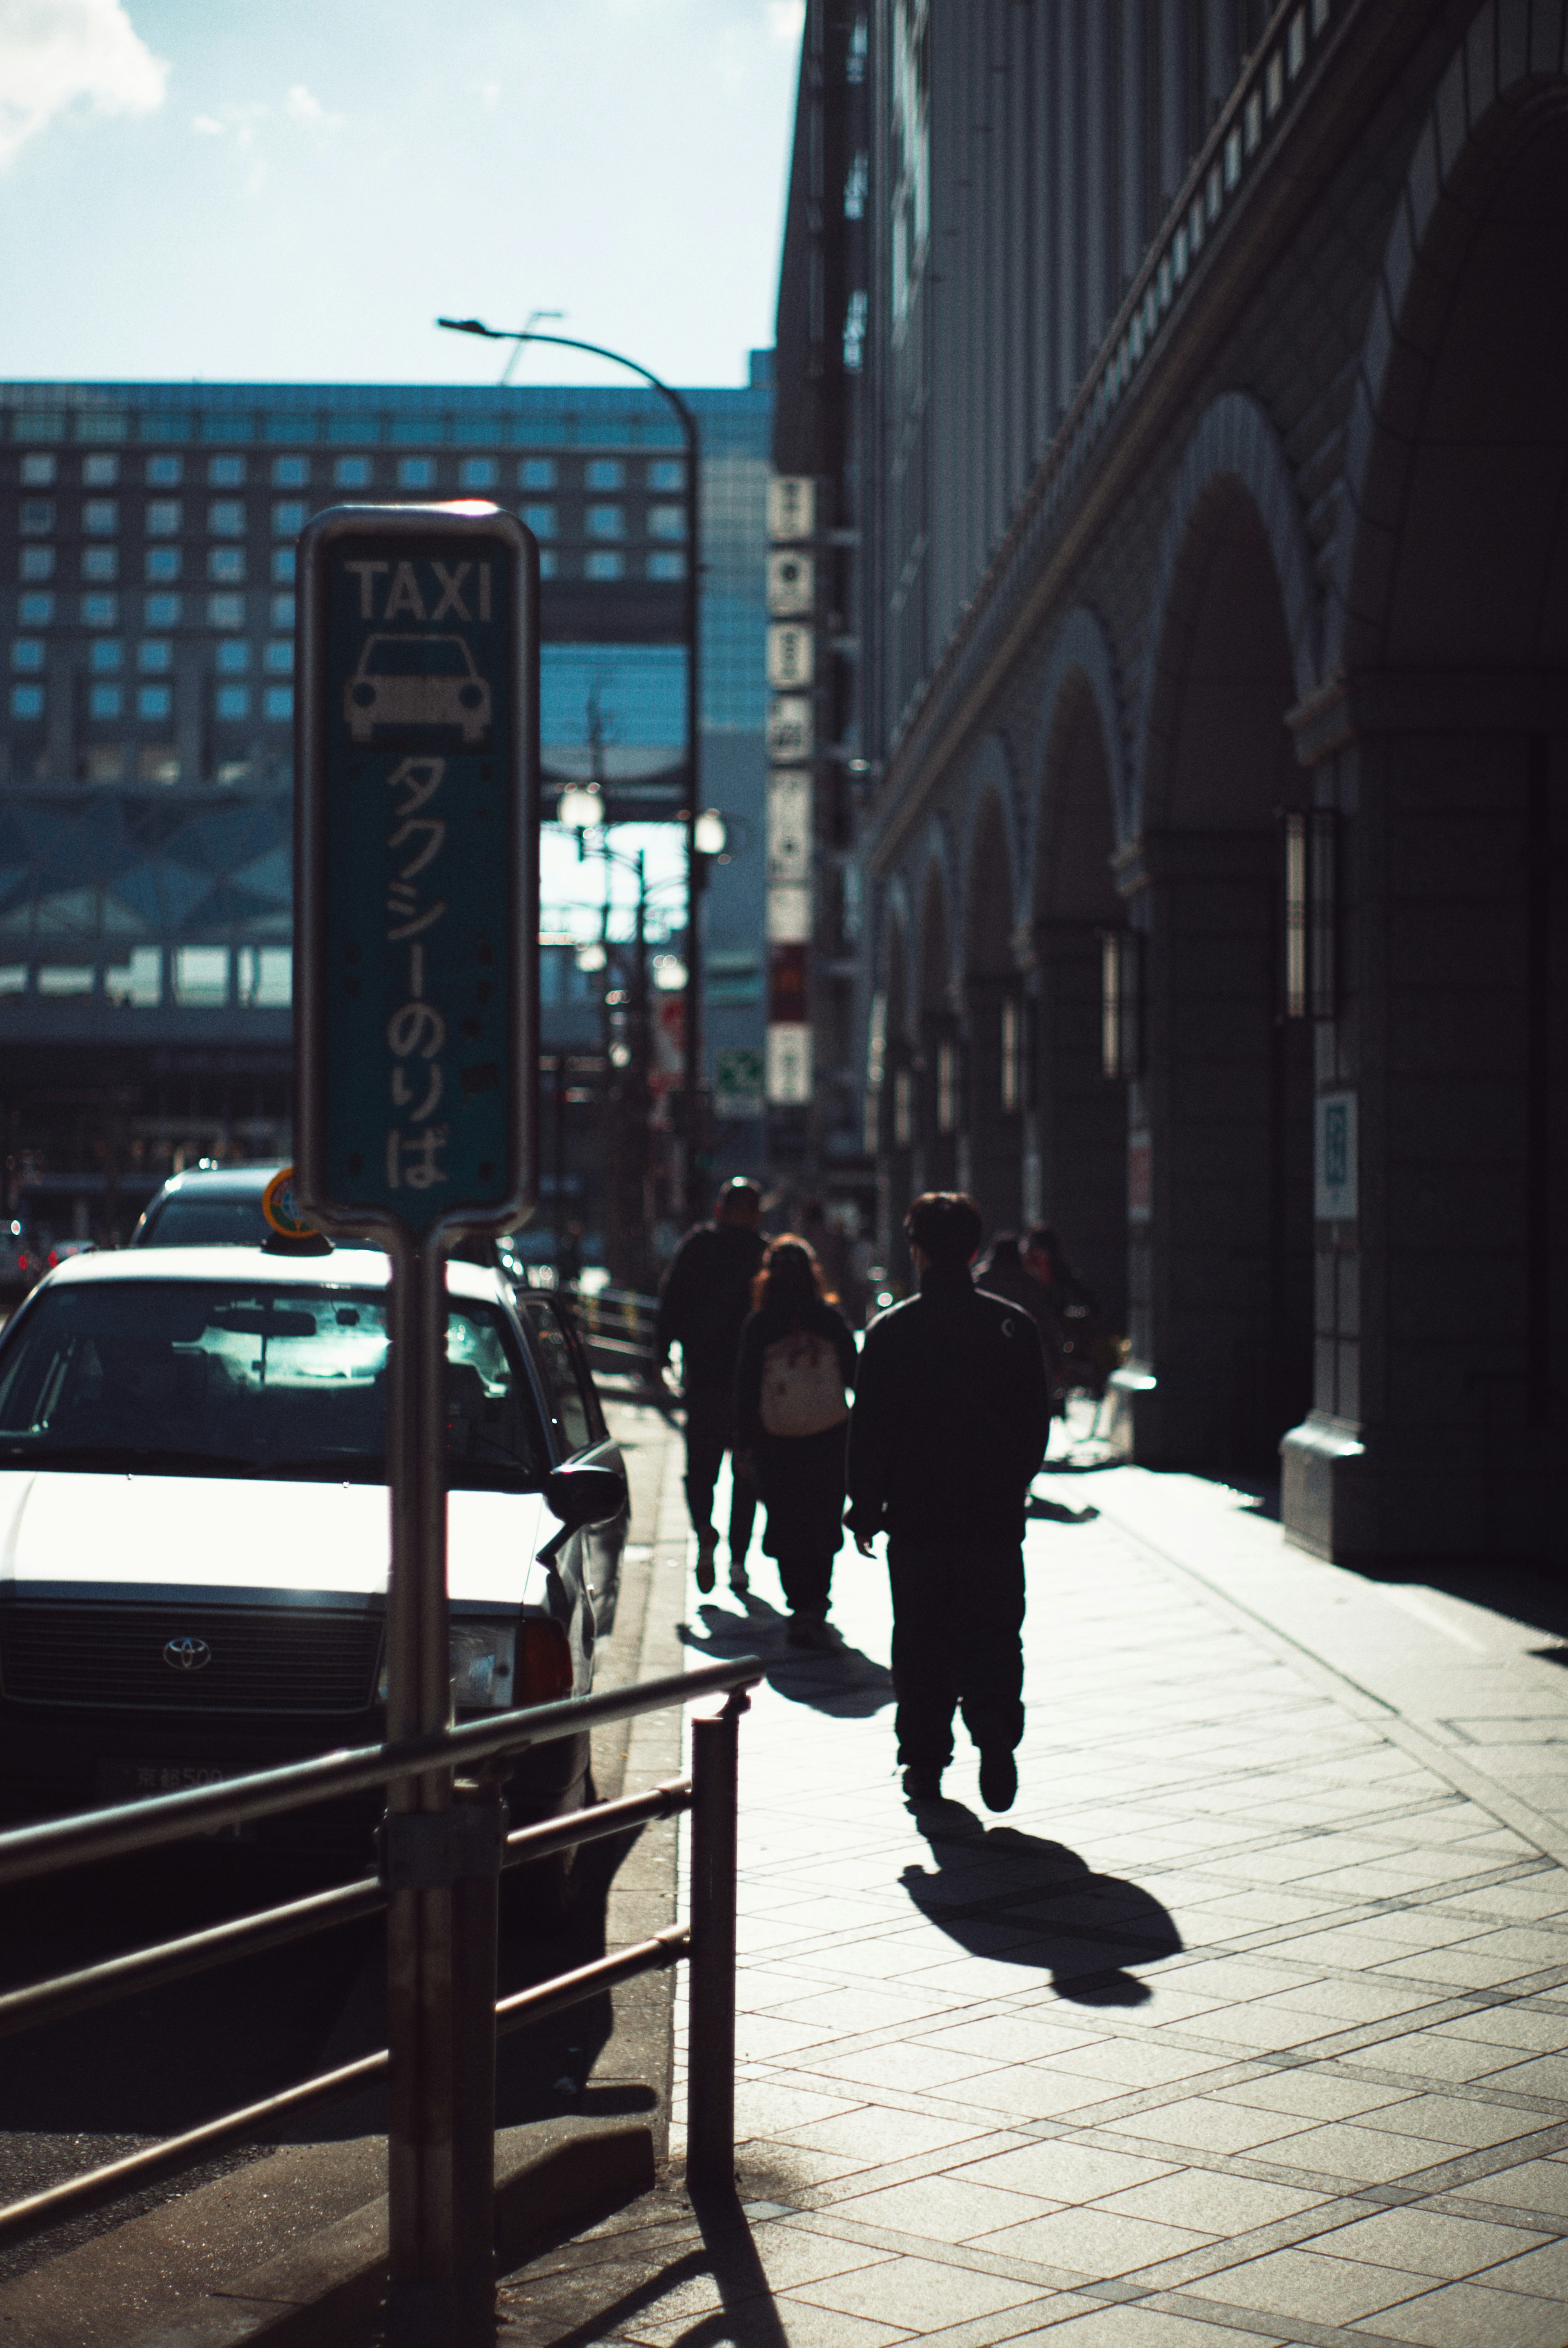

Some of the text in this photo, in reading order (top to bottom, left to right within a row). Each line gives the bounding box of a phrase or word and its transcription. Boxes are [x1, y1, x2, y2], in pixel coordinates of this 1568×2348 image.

[344, 561, 492, 622] TAXI
[386, 756, 448, 1190] タクシーのりば
